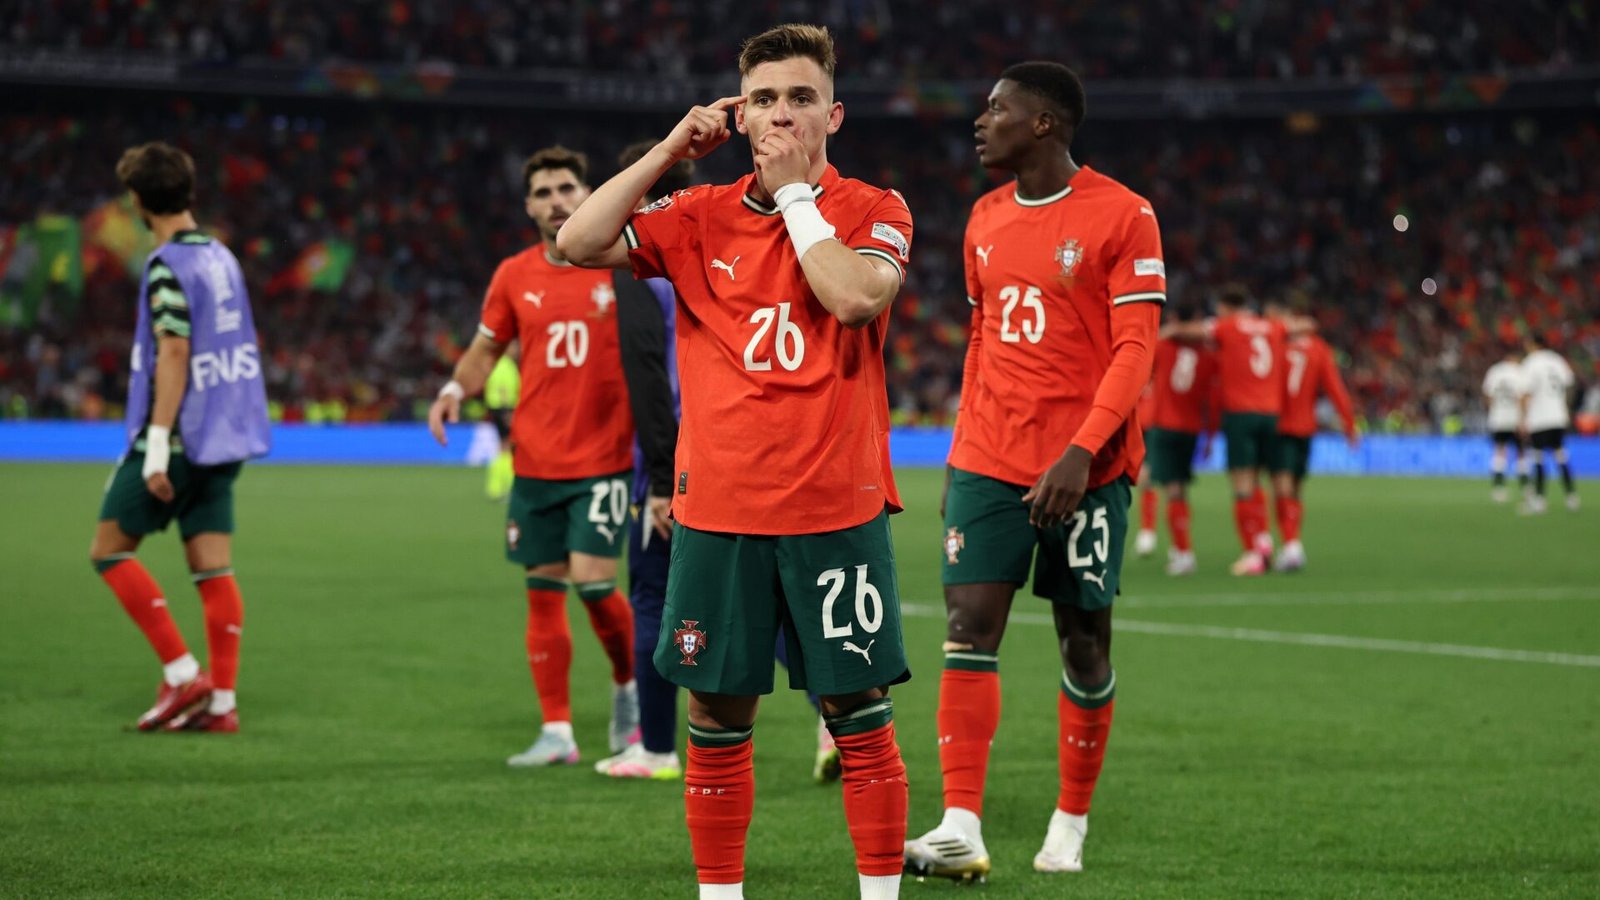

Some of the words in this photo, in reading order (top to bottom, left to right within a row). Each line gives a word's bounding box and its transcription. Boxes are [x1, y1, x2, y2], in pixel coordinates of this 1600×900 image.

[743, 302, 805, 371] 26
[999, 286, 1046, 344] 25
[546, 320, 589, 368] 20
[1250, 335, 1273, 379] 3
[1286, 349, 1307, 396] 7
[588, 479, 628, 526] 20
[1064, 506, 1110, 568] 25
[817, 563, 884, 639] 26
